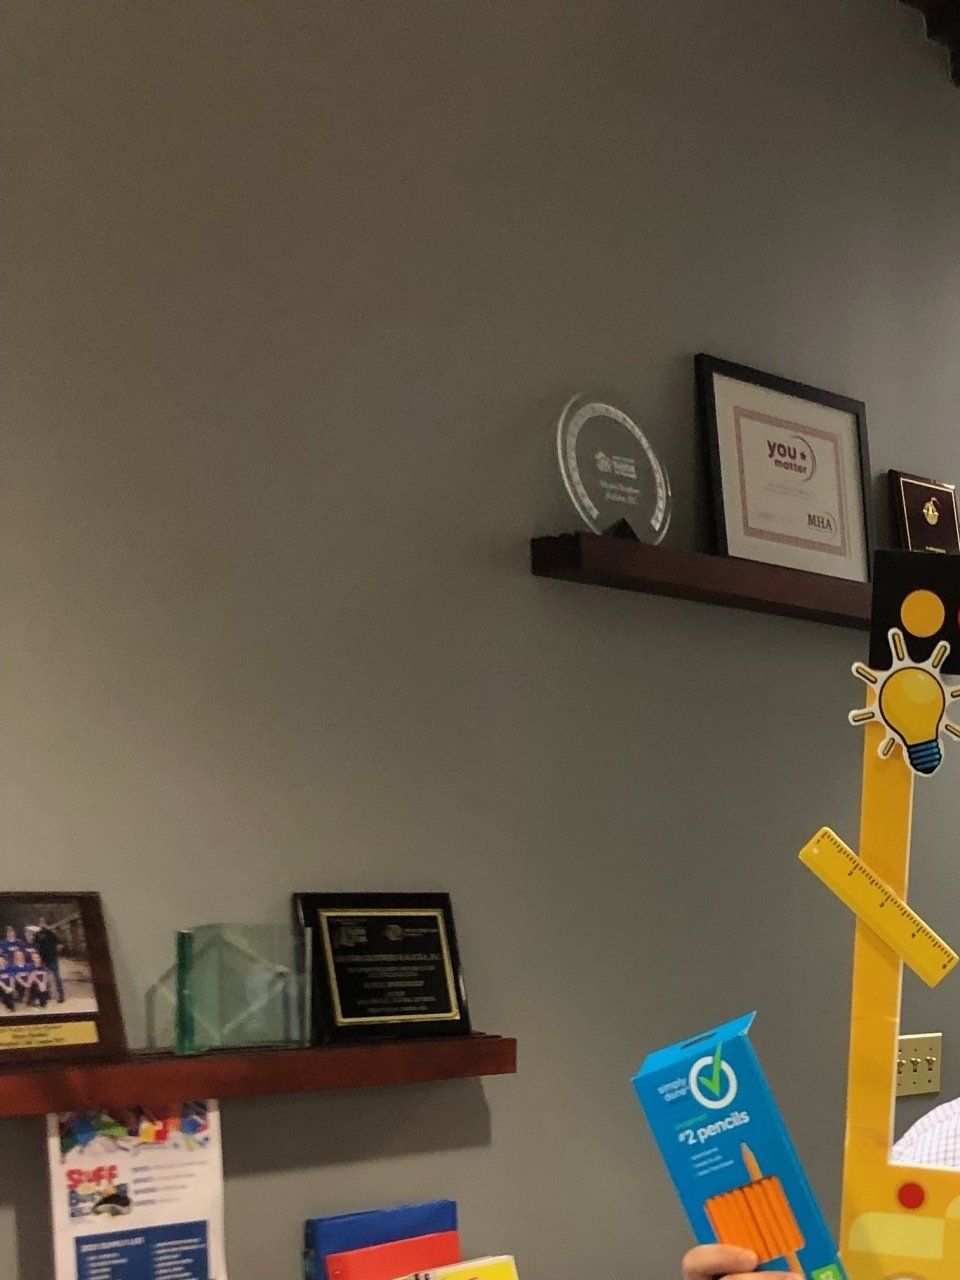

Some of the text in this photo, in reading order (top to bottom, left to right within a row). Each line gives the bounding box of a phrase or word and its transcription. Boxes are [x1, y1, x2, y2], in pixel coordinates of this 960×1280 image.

[767, 440, 797, 460] you
[774, 459, 808, 474] matter
[807, 513, 833, 531] MHA
[697, 1110, 751, 1144] pencils
